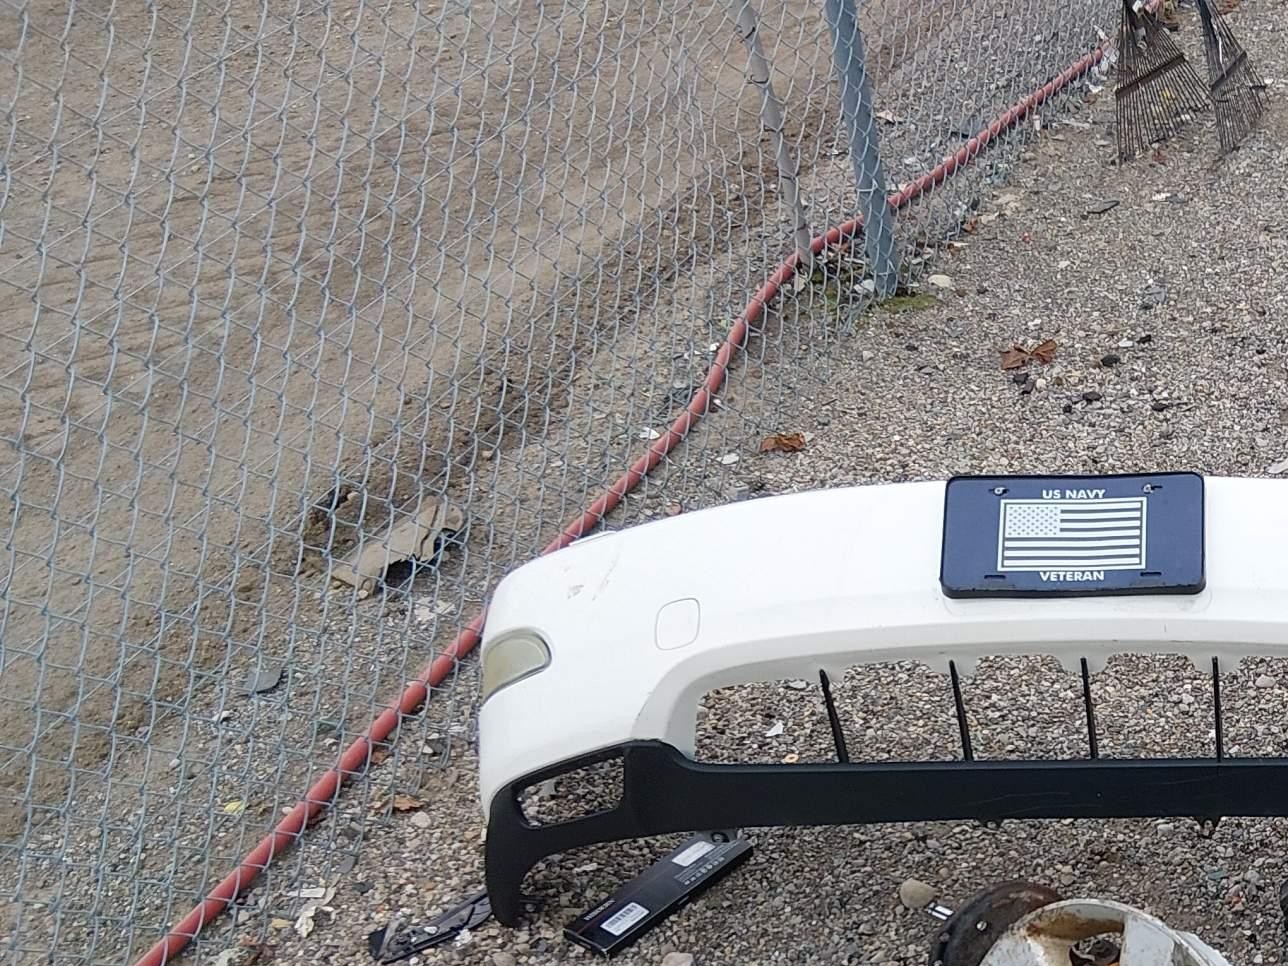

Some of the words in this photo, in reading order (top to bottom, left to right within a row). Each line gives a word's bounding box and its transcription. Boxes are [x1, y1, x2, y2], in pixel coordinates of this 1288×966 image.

[1042, 489, 1061, 499] US
[1065, 489, 1106, 499] NAVY
[1039, 571, 1105, 582] VETERAN
